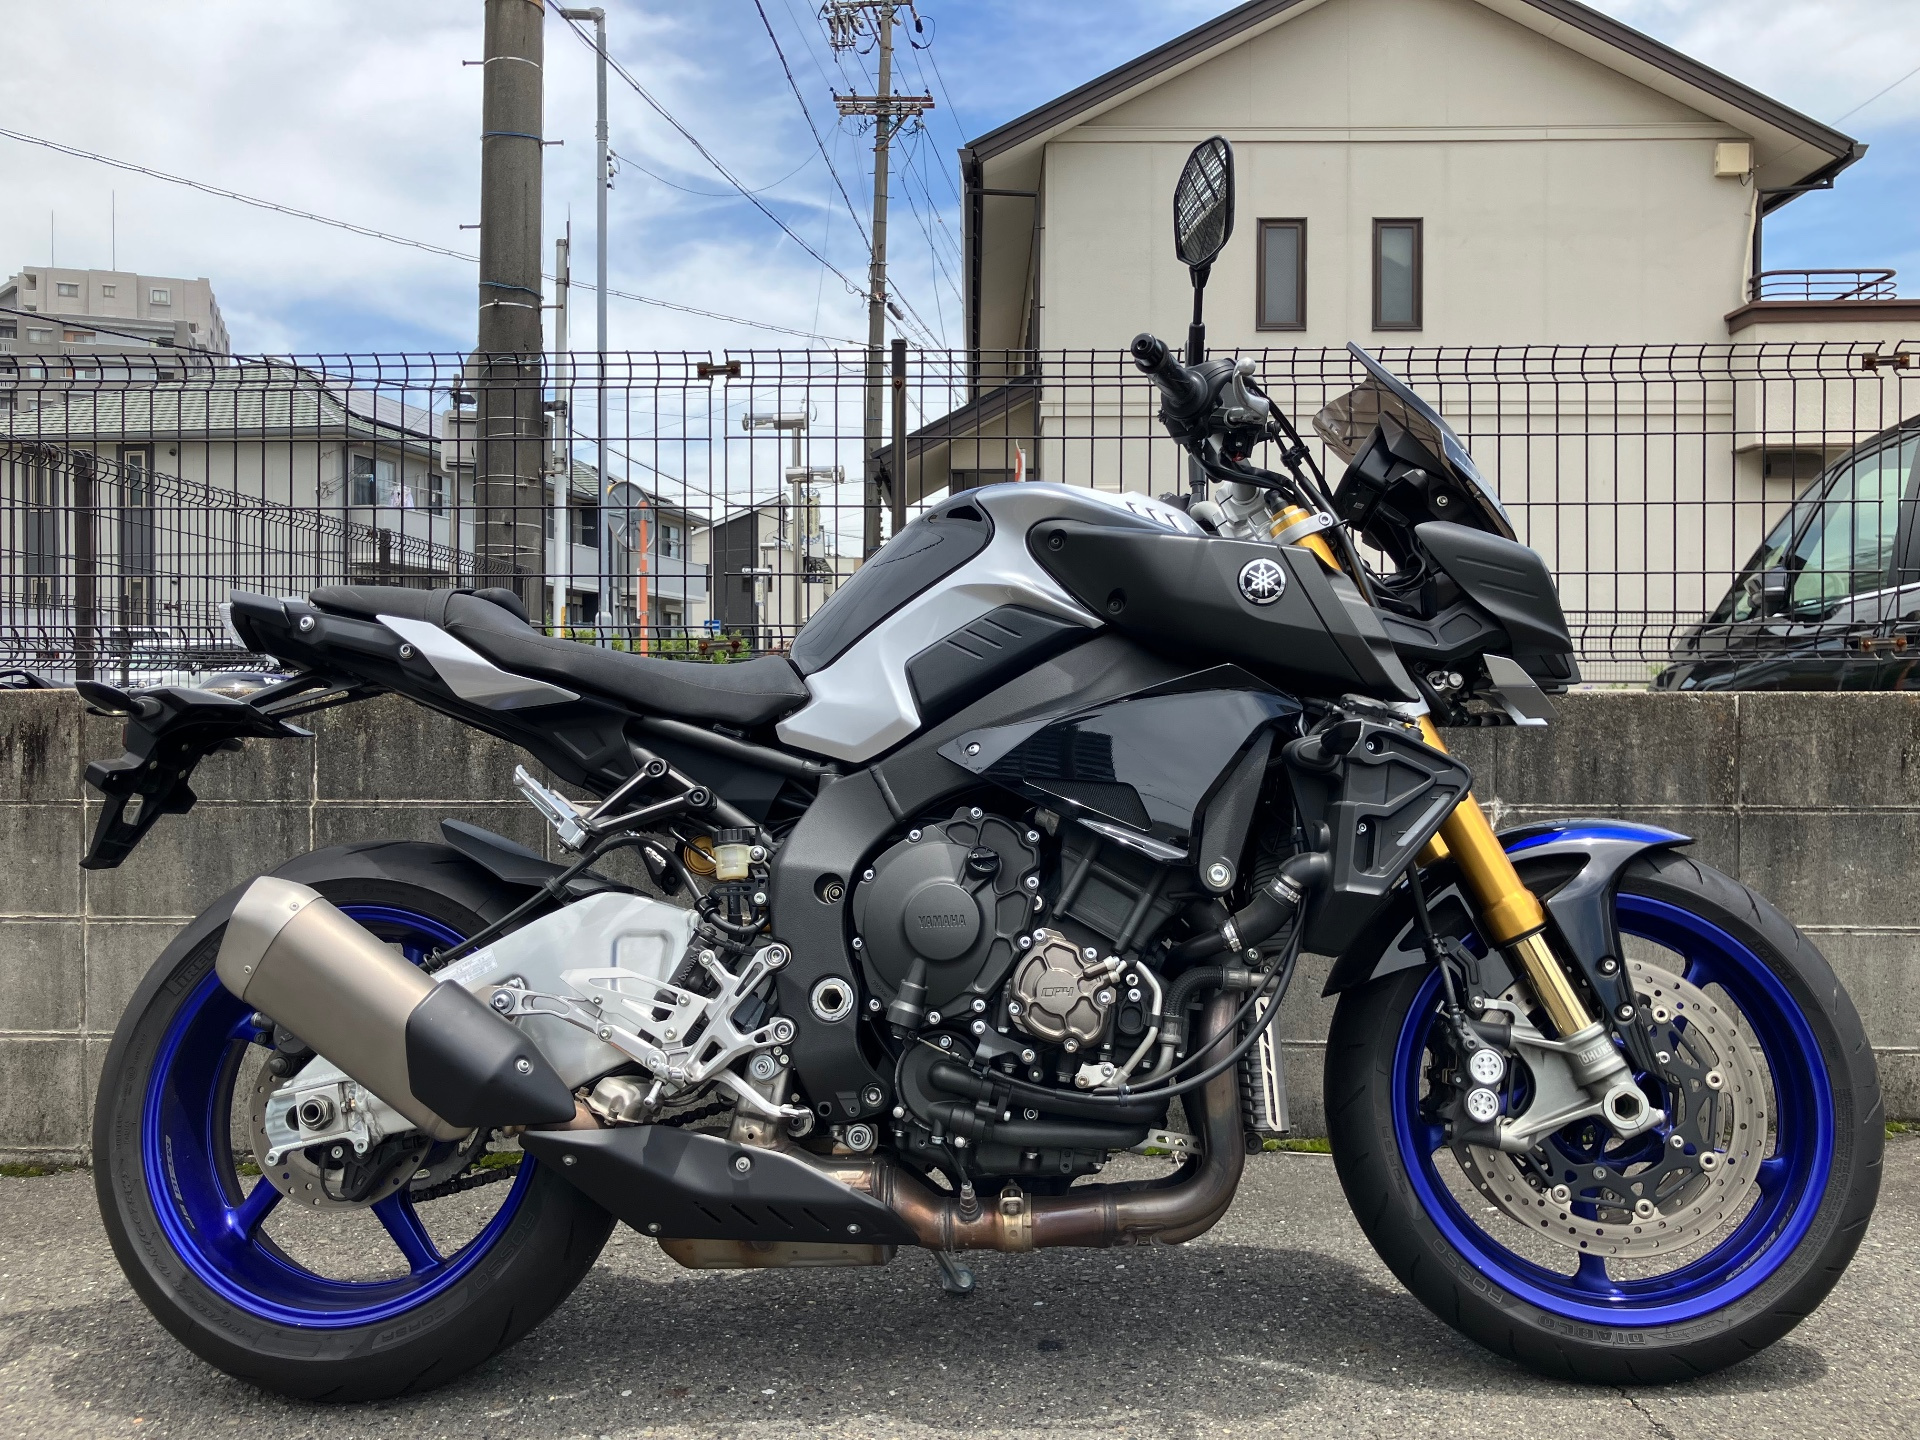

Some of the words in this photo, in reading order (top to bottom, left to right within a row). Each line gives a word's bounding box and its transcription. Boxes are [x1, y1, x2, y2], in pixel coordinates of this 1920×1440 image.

[918, 914, 967, 928] YAMAHA
[1381, 1124, 1409, 1196] CORSA
[471, 1210, 537, 1291] ROSSO
[1430, 1236, 1504, 1304] ROSSO
[380, 1304, 448, 1343] CORSA
[1535, 1313, 1645, 1345] DIABLO
